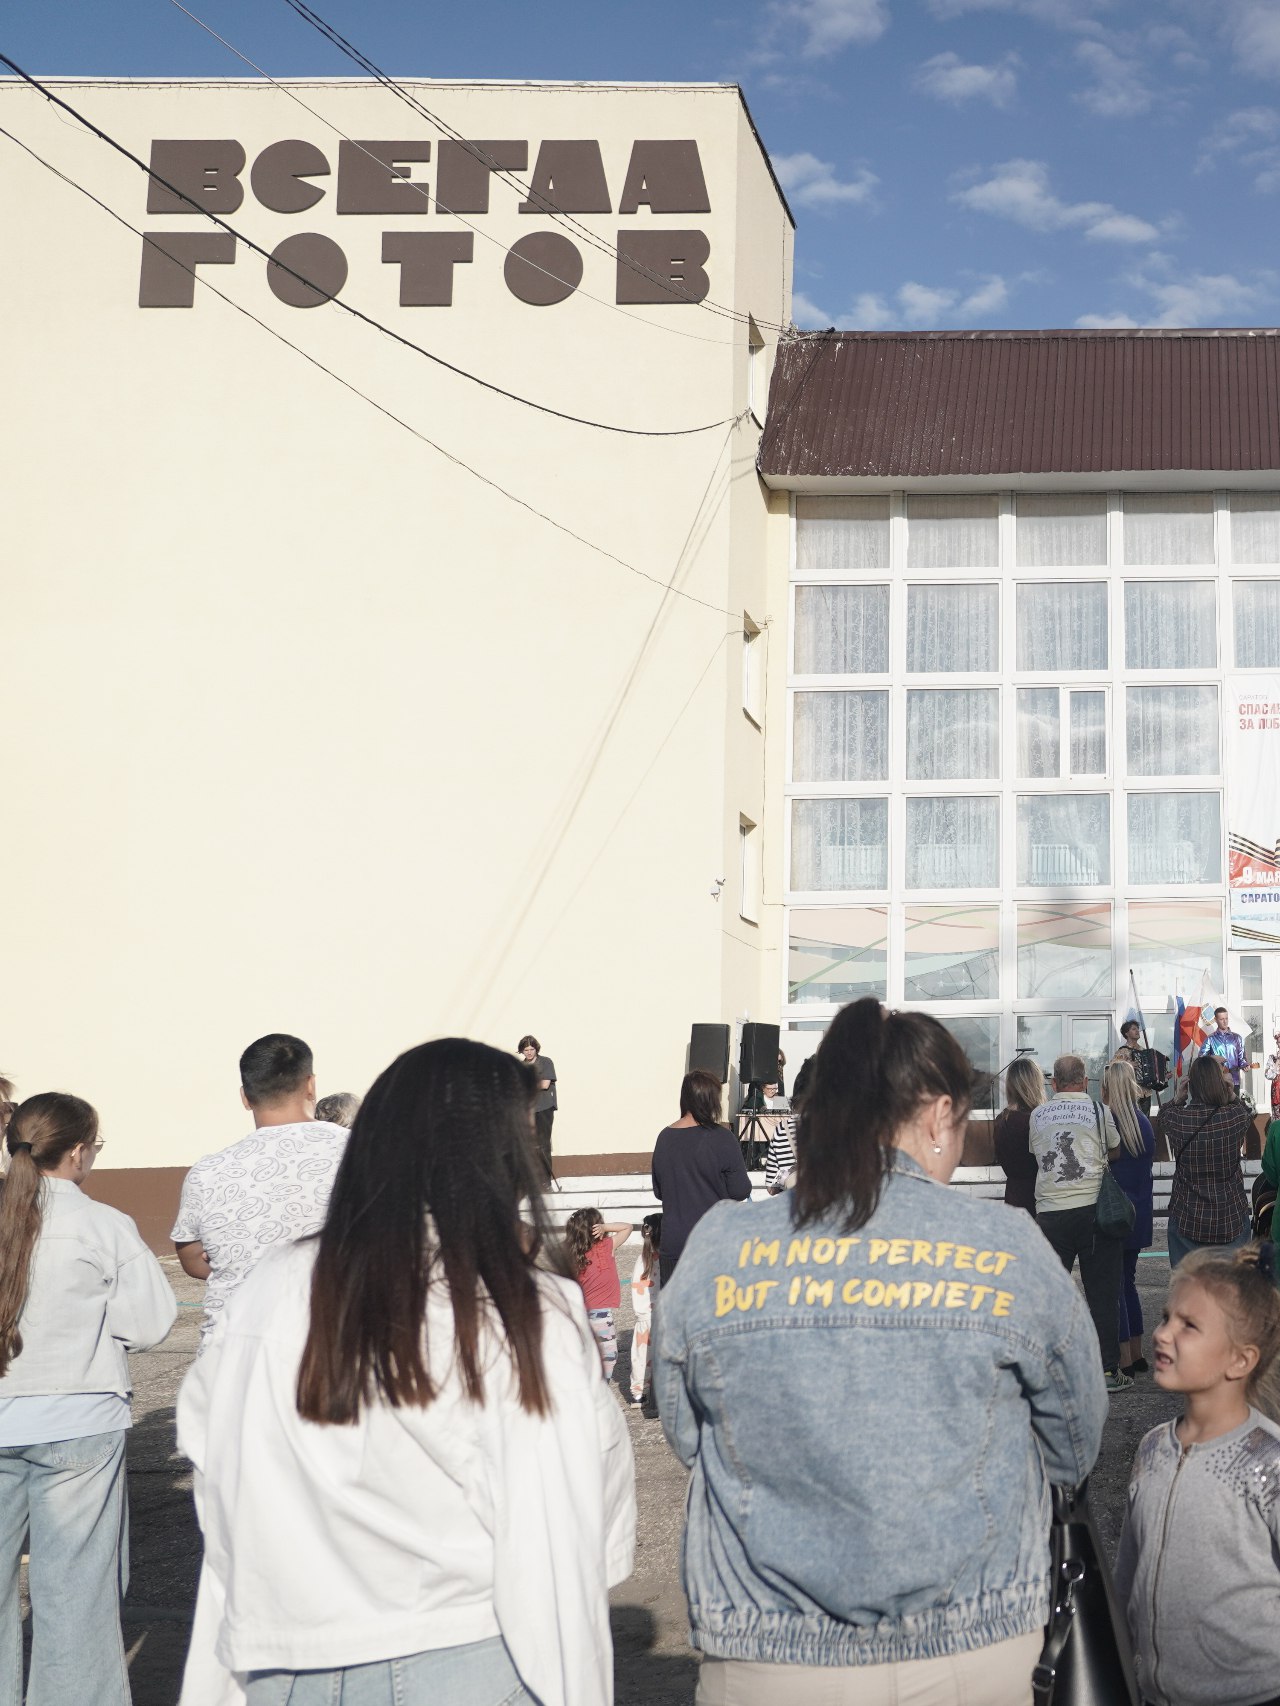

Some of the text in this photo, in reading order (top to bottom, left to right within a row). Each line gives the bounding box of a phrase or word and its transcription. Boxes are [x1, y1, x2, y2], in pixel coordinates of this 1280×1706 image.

[147, 139, 711, 214] ВСЕГДА
[139, 230, 710, 308] ГОТОВ
[1239, 718, 1254, 730] ЗА
[1242, 866, 1253, 884] 9
[738, 1235, 1018, 1277] I'M NOT PERFECT
[787, 1275, 835, 1309] I'M
